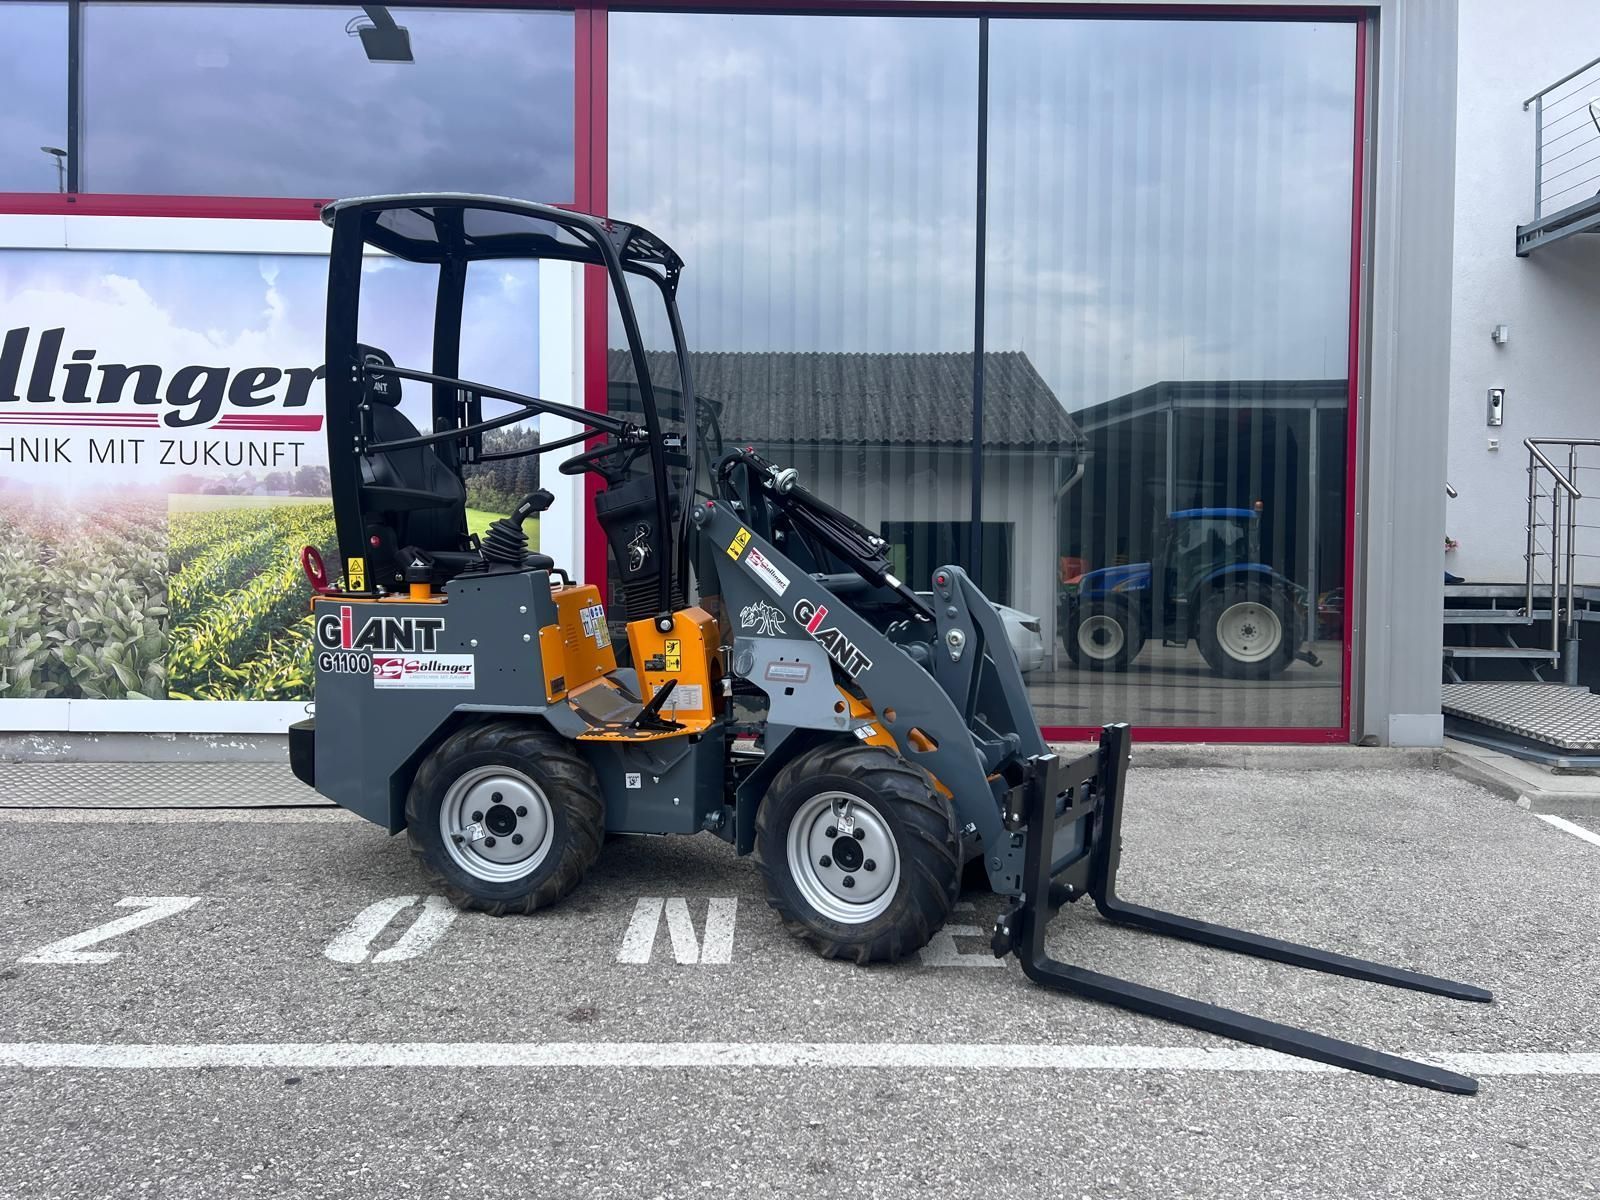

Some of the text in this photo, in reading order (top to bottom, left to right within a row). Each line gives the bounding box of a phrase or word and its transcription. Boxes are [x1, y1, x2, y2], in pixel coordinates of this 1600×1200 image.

[89, 438, 145, 464] MIT
[160, 440, 305, 467] ZUKUNFT
[319, 652, 371, 674] G1100
[404, 660, 472, 674] Söllinger
